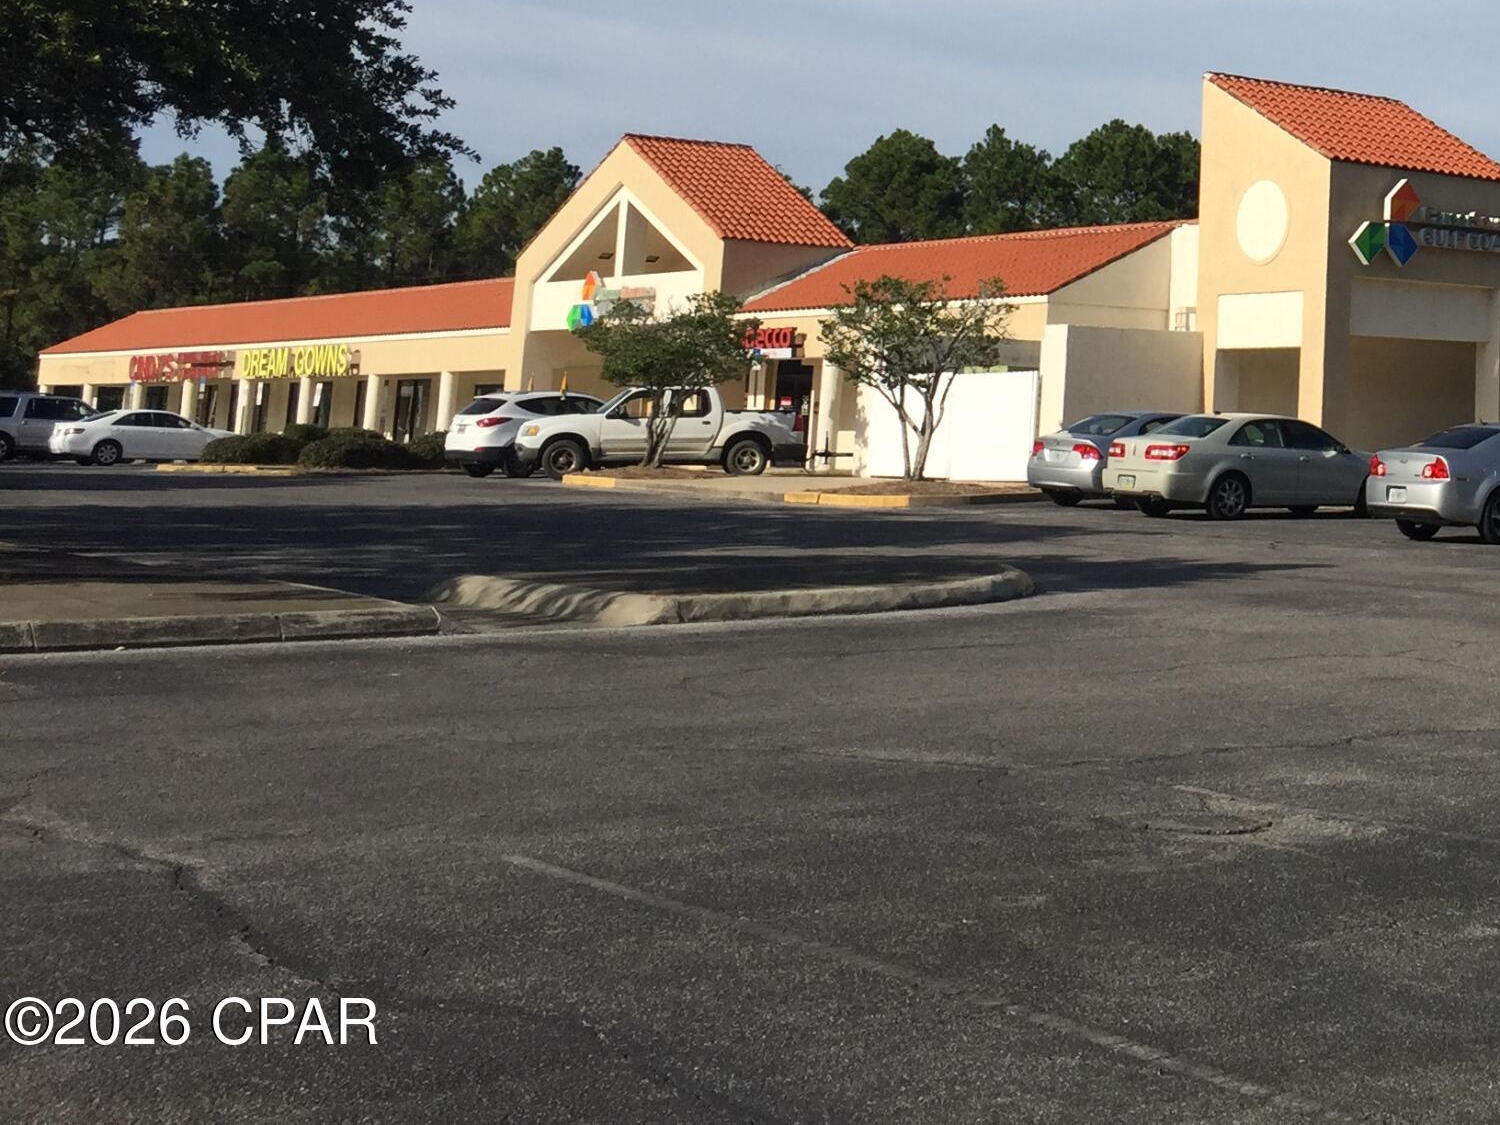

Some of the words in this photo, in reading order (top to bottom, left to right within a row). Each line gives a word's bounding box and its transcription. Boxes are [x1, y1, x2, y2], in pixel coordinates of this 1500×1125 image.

[1419, 227, 1466, 250] GULF
[240, 347, 289, 376] DREAM
[294, 343, 348, 375] GOWNS
